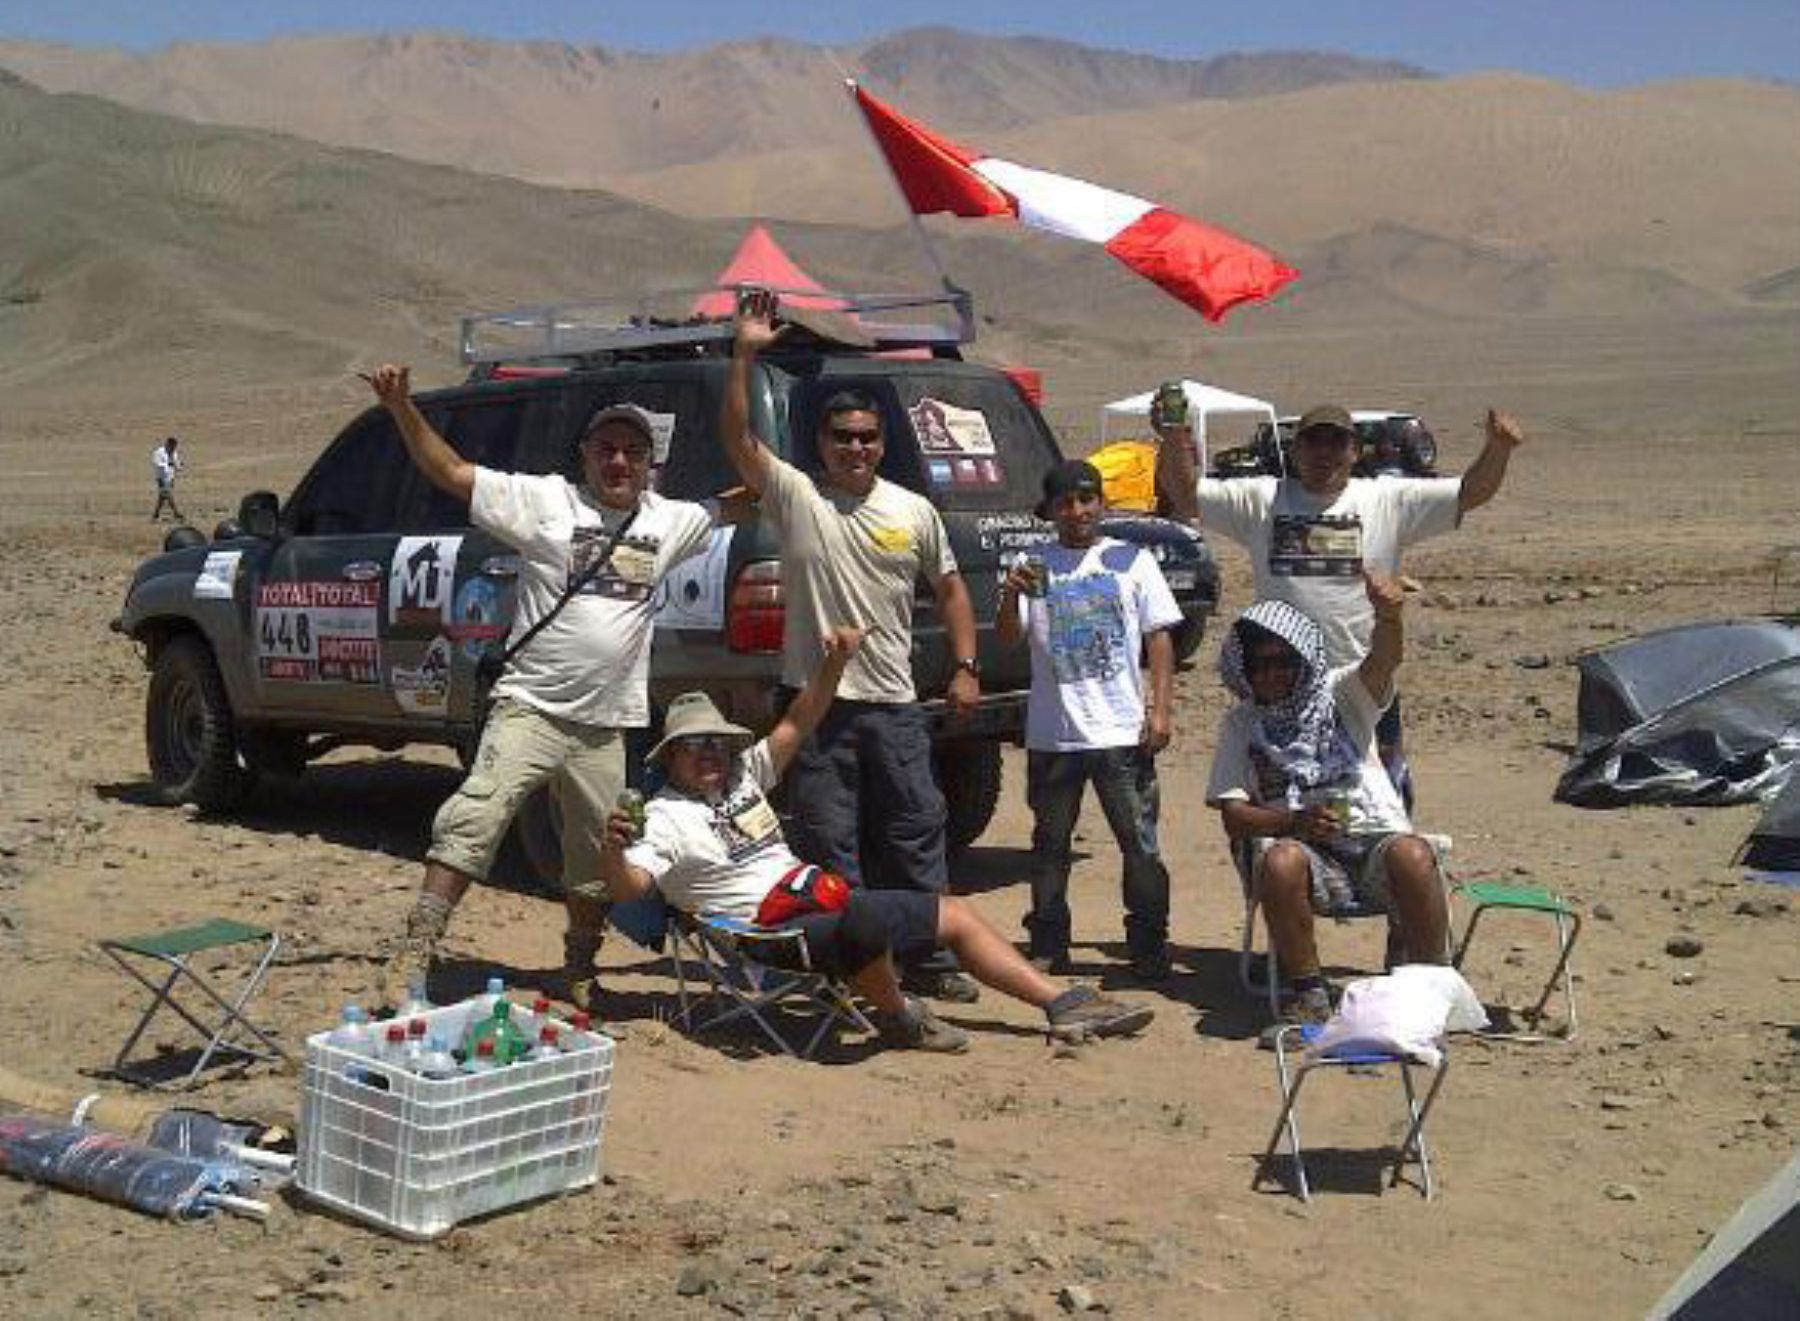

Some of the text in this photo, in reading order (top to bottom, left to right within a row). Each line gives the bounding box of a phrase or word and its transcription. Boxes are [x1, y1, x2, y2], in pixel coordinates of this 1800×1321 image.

[261, 582, 377, 605] TOTAL TOTAL
[262, 611, 311, 654] 448
